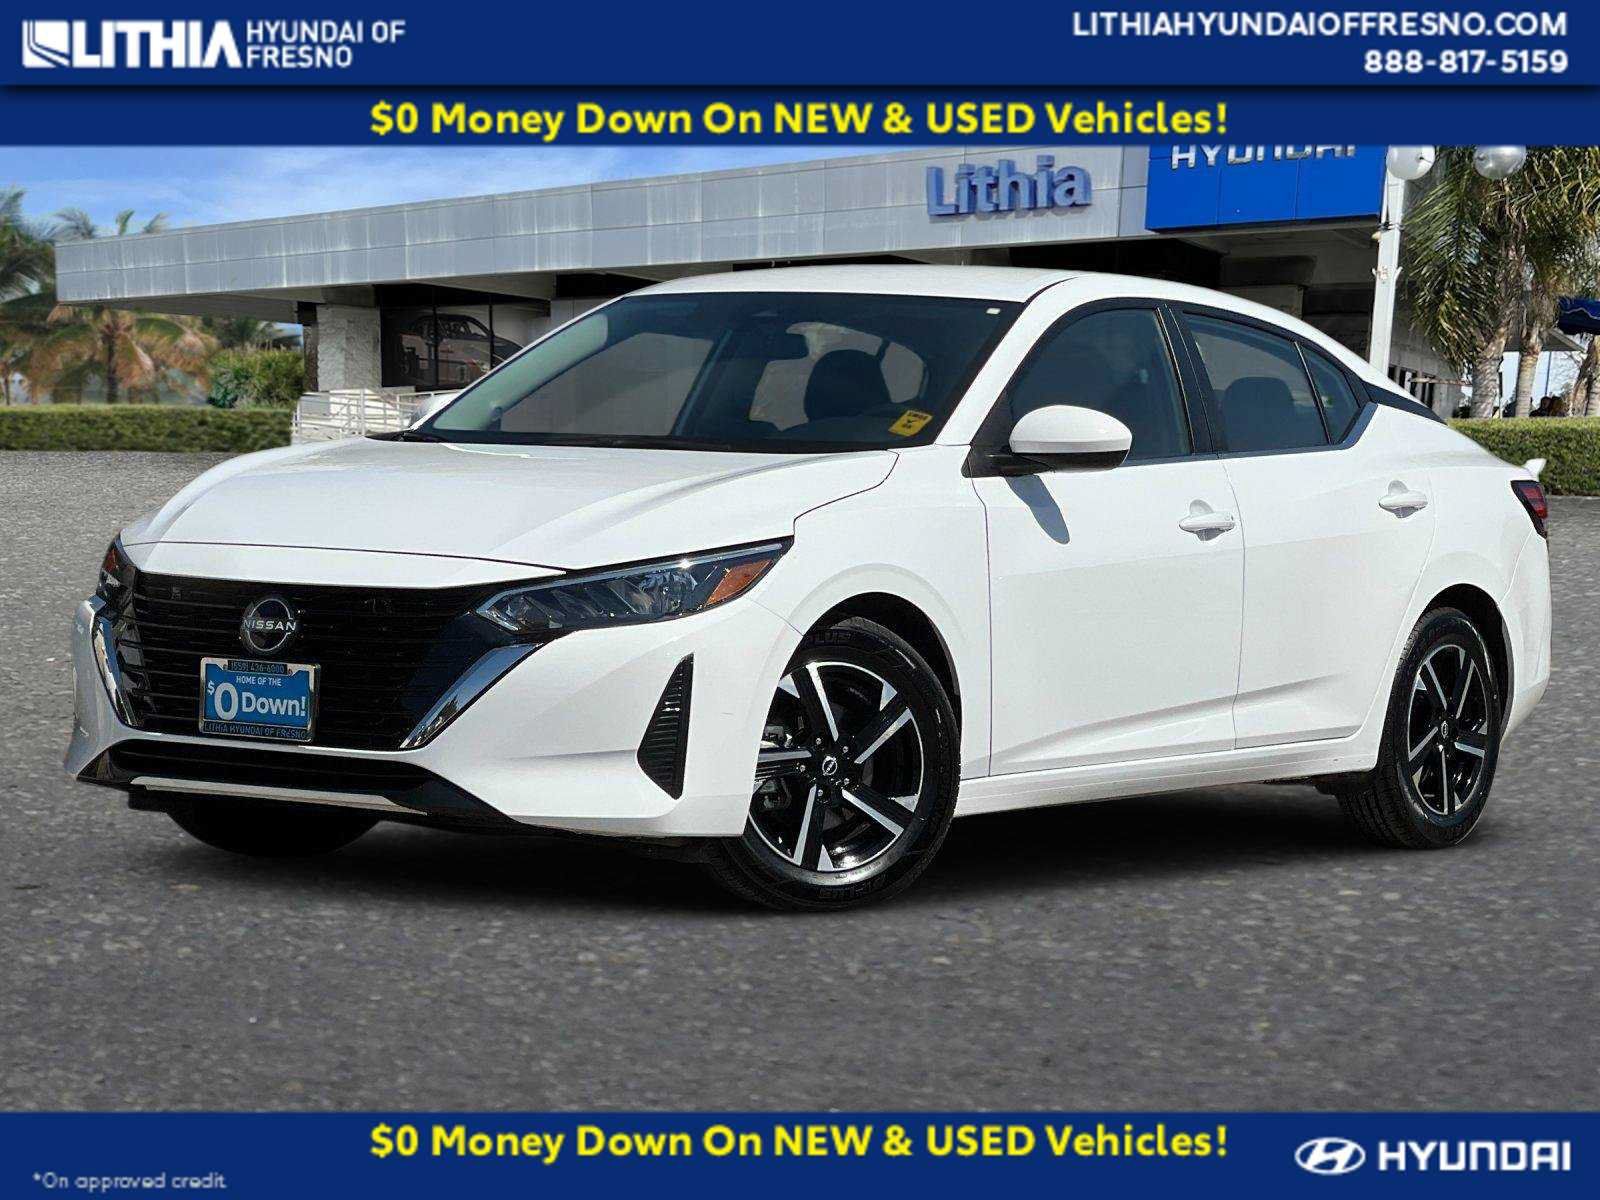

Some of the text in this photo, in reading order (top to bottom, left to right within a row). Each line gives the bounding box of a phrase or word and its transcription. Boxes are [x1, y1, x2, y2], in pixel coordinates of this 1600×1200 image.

[926, 155, 1092, 216] Lithia
[243, 619, 296, 631] NISSAN
[236, 676, 282, 687] HOME OF THE
[207, 680, 306, 720] $0 Down!
